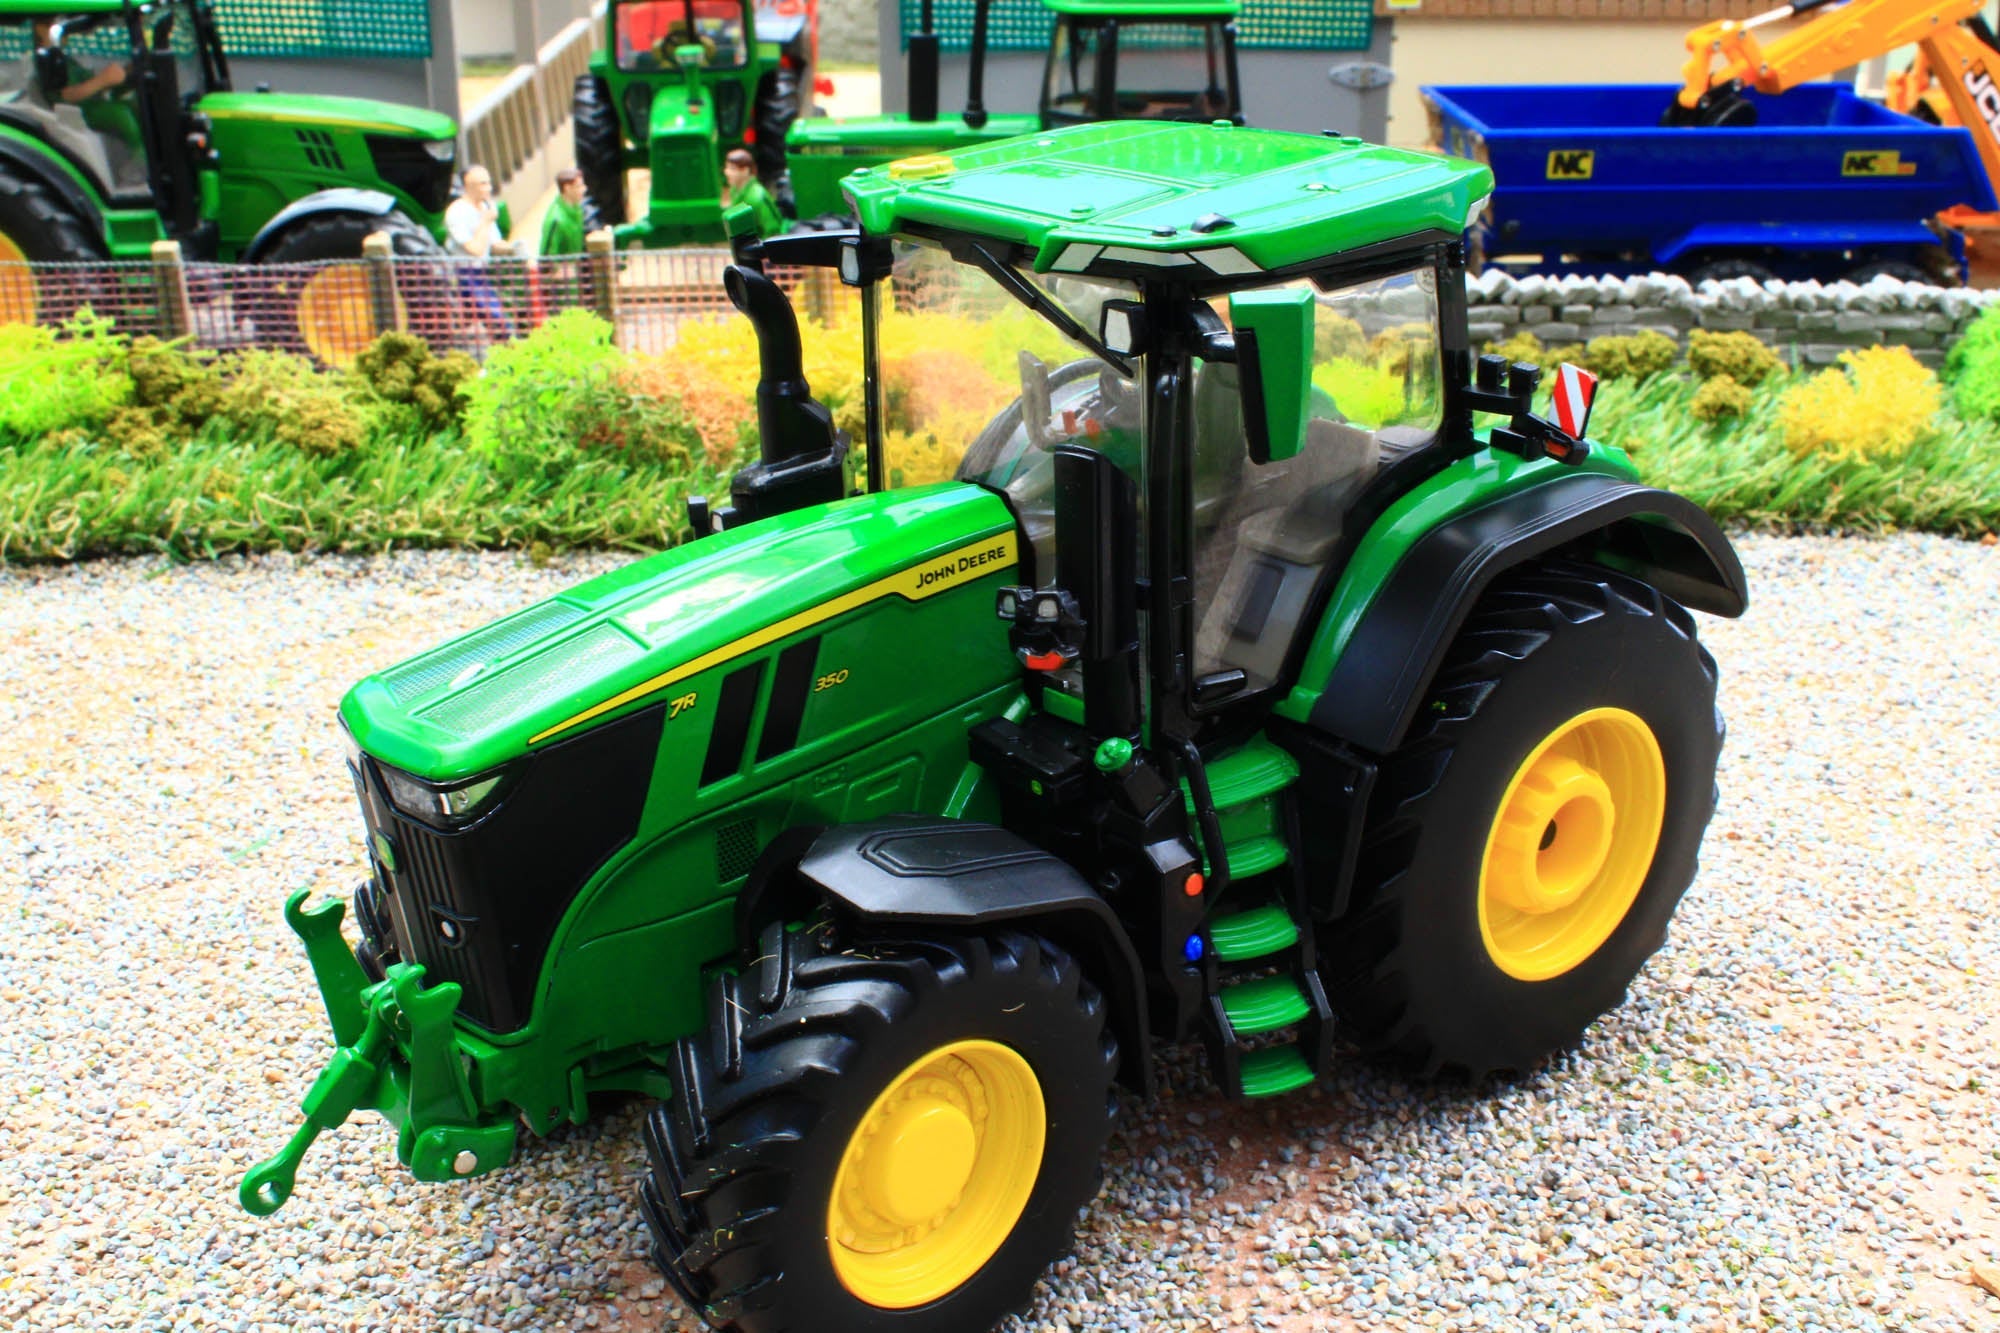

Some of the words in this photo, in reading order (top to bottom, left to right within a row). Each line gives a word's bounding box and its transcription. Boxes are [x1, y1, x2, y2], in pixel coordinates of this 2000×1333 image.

[1553, 152, 1589, 175] NC
[1845, 154, 1878, 172] NC
[916, 564, 955, 589] JOHN
[958, 546, 1006, 572] DEERE
[814, 669, 849, 692] 350
[670, 692, 697, 719] 7R
